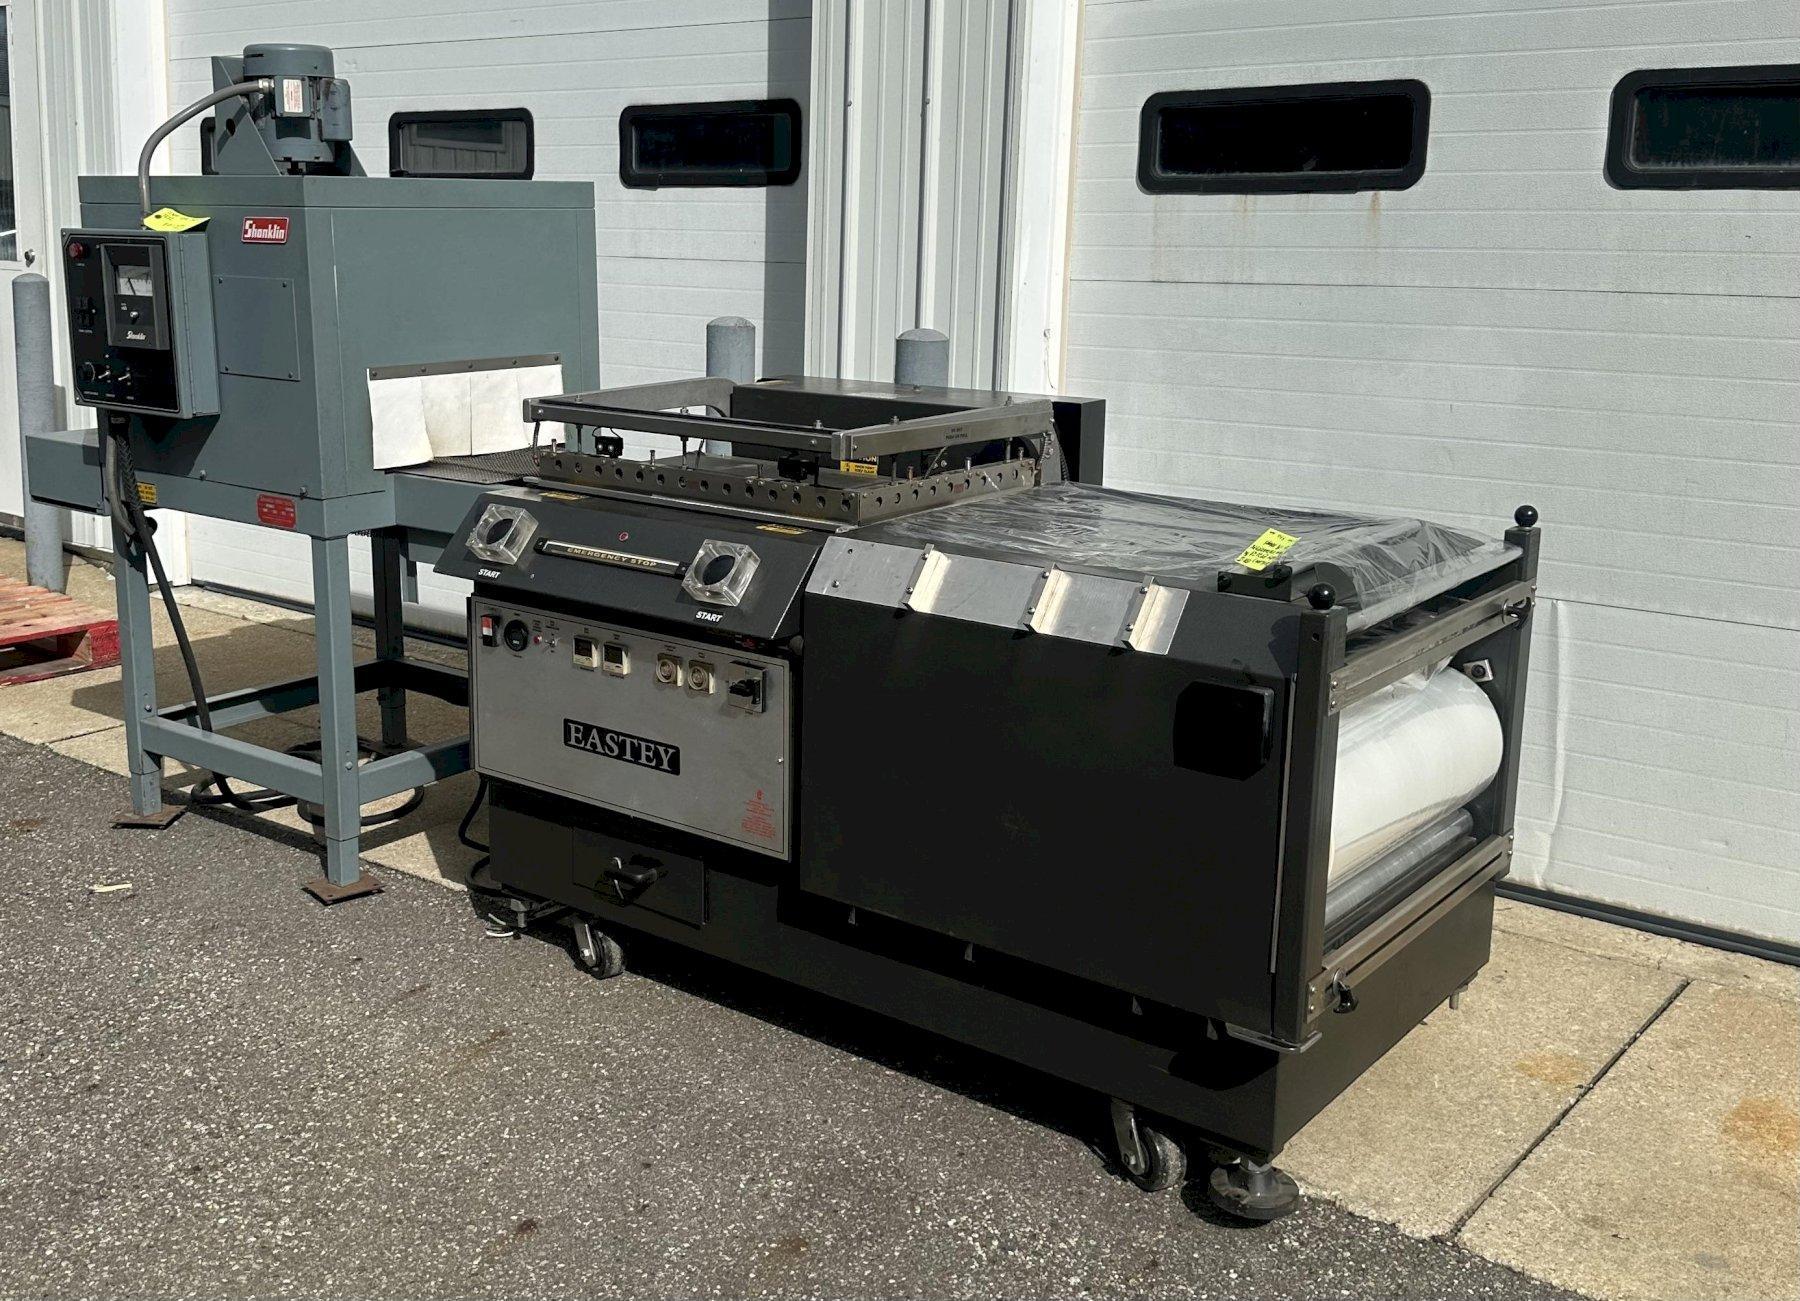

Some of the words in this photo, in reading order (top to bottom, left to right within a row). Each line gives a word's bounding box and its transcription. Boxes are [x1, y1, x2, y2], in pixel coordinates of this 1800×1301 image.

[244, 220, 285, 239] Shanklin
[567, 547, 628, 562] EMERGENCY
[630, 558, 657, 567] STOP
[478, 568, 501, 579] START
[695, 611, 723, 622] START
[567, 722, 676, 771] EASTEY
